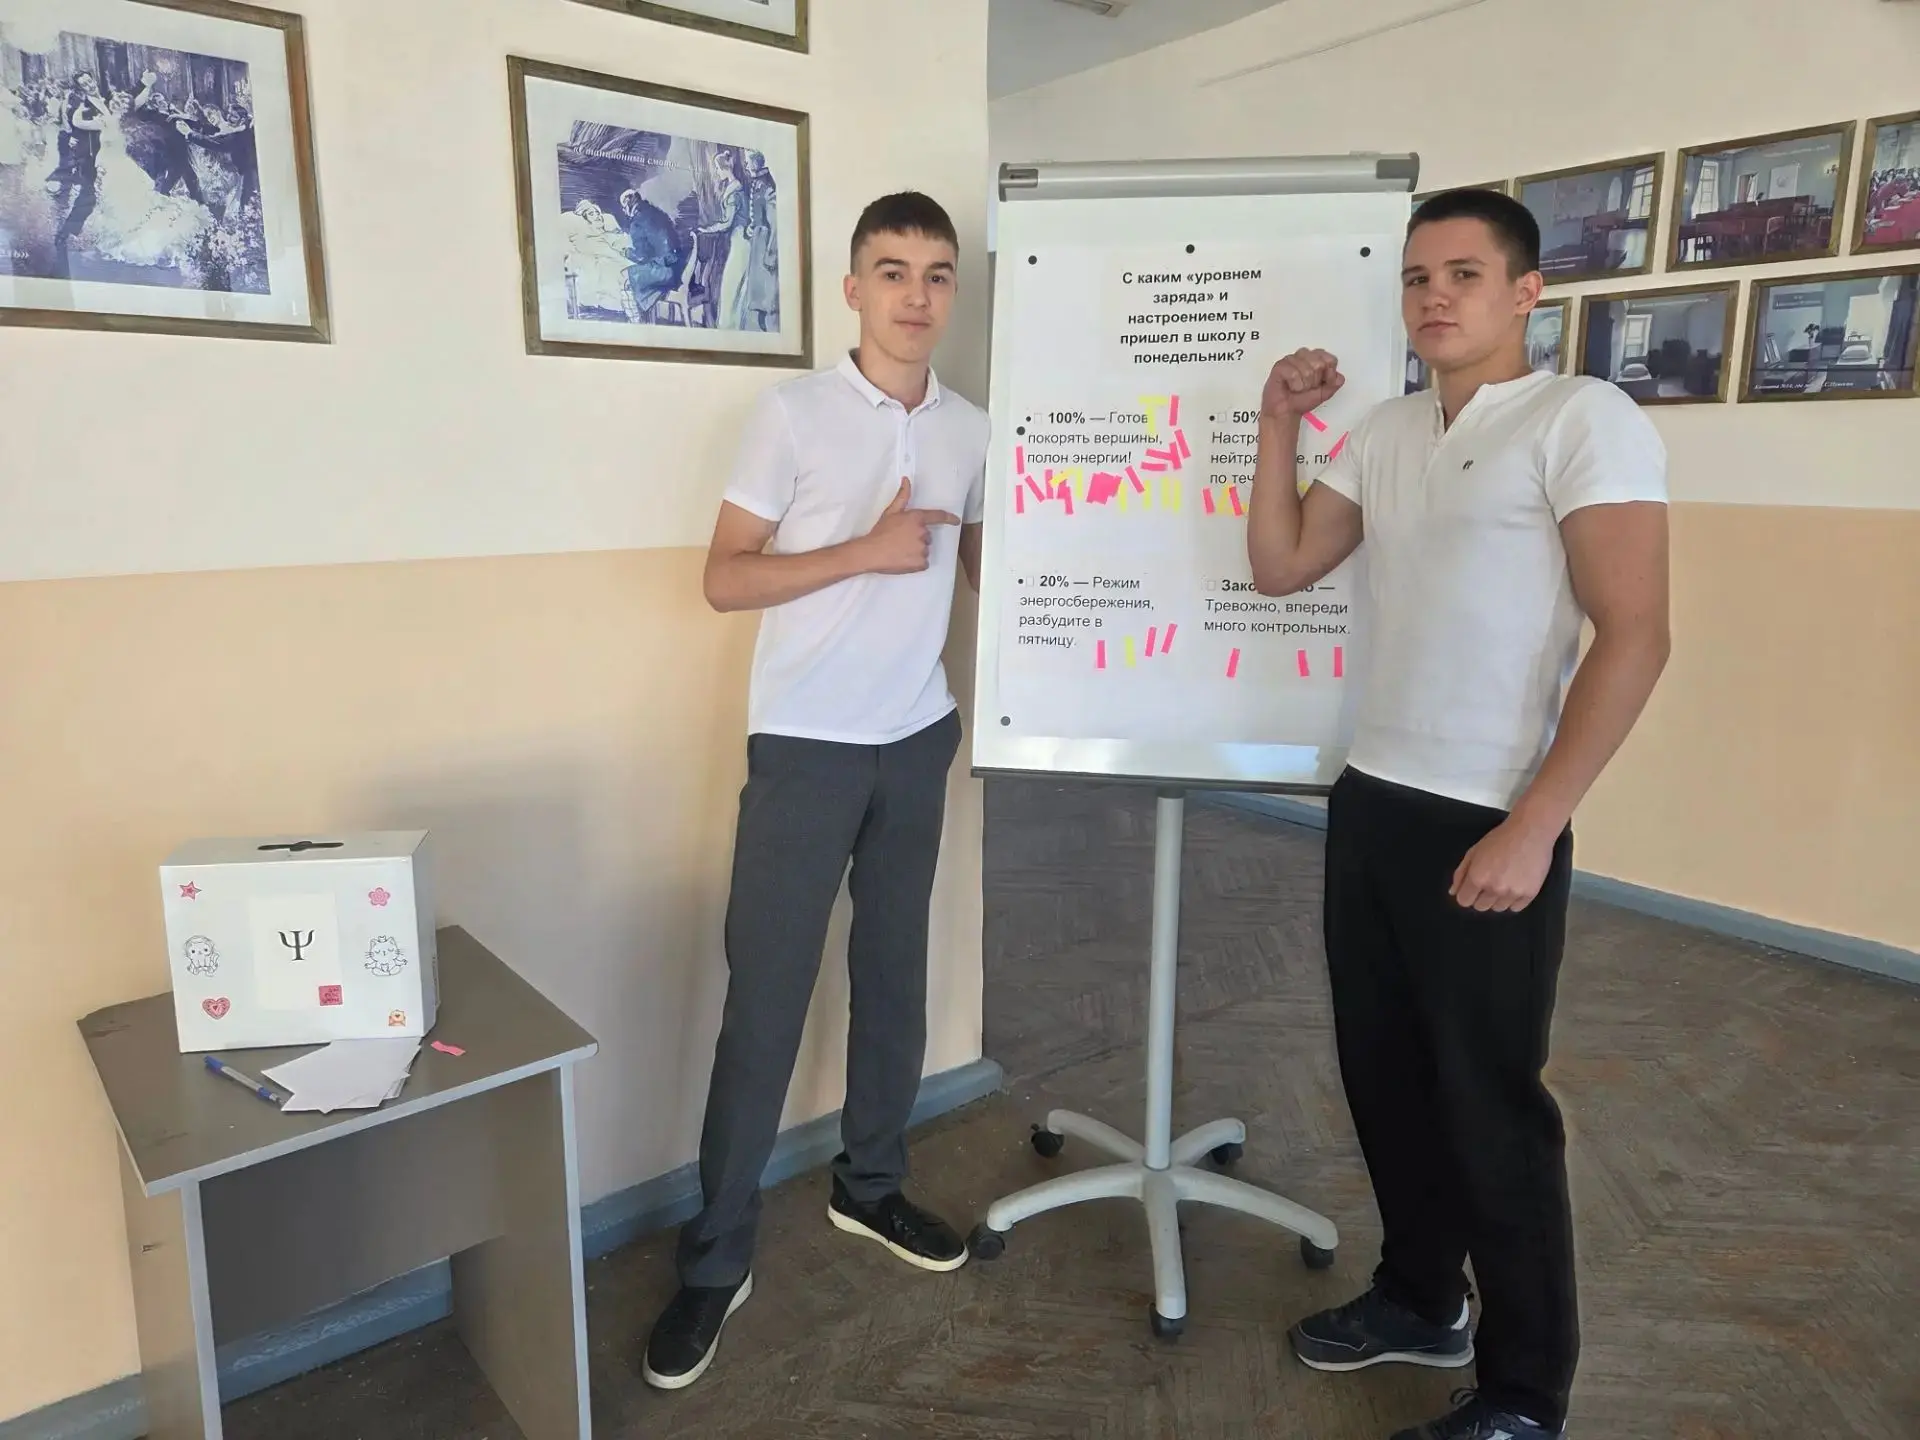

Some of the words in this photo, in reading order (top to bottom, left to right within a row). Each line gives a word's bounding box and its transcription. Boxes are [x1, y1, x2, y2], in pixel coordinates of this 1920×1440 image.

[1122, 272, 1133, 284] С
[1137, 273, 1181, 284] каким
[1186, 269, 1261, 285] «уровнем
[1153, 292, 1214, 305] заряда»
[1219, 291, 1228, 301] и
[1128, 311, 1227, 326] настроением
[1232, 311, 1253, 321] ты
[1120, 333, 1179, 347] пришел
[1183, 333, 1192, 343] в
[1197, 331, 1246, 344] школу
[1251, 330, 1260, 341] в
[1134, 348, 1244, 364] понедельник?
[1048, 411, 1085, 424] 100%
[1109, 411, 1148, 424] Готов
[1028, 434, 1090, 446] покорять
[1094, 433, 1163, 446] вершины,
[1027, 454, 1068, 464] полон
[1072, 451, 1132, 466] энергии!
[1210, 474, 1227, 484] по
[1040, 575, 1069, 588] 20%
[1093, 576, 1140, 589] Режим
[1020, 595, 1154, 611] энергосбережения,
[1204, 598, 1280, 614] Тревожно,
[1285, 602, 1348, 616] впереди
[1019, 614, 1091, 629] разбудите
[1095, 617, 1103, 627] в
[1204, 621, 1246, 632] много
[1251, 621, 1351, 635] контрольных.
[1018, 635, 1077, 649] пятницу.
